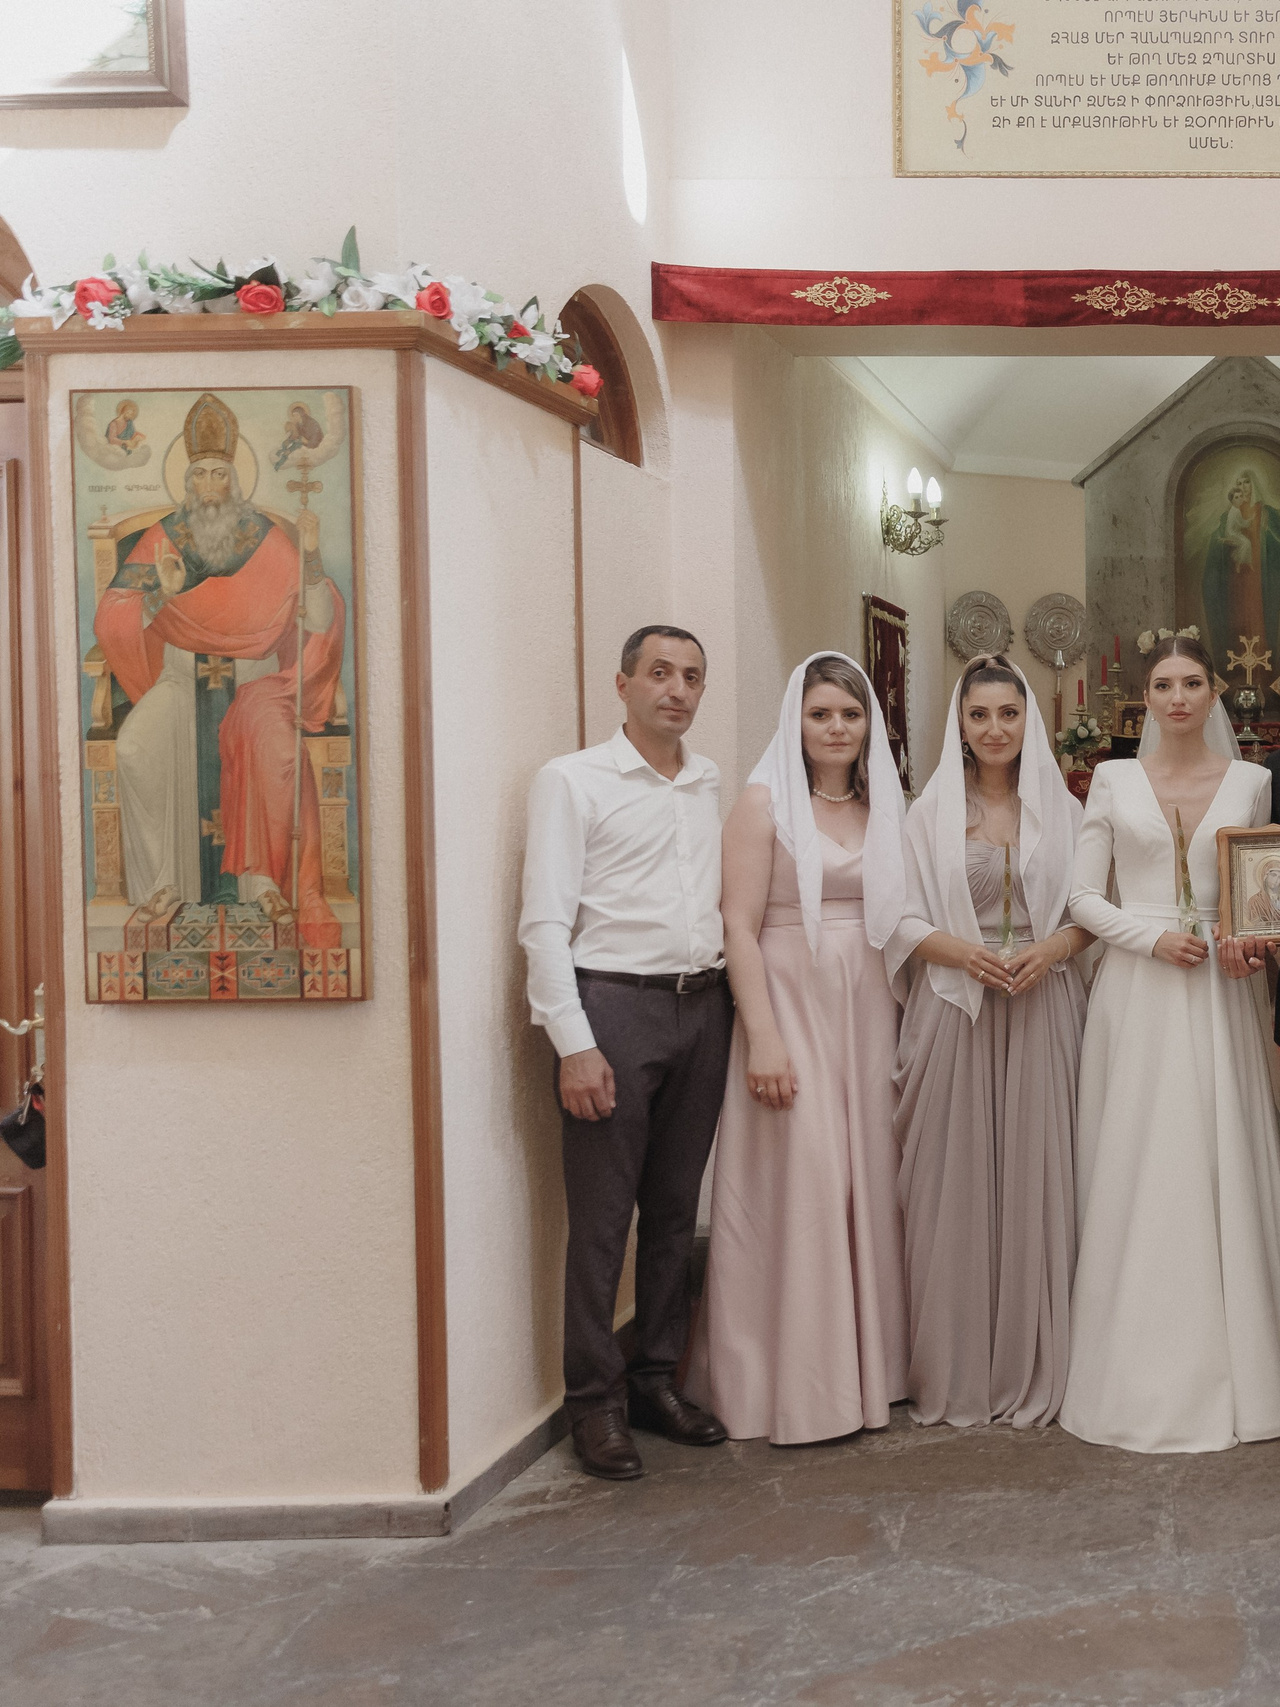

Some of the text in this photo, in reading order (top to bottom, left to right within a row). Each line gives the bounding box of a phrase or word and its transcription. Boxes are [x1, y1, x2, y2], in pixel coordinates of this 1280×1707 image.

[1104, 9, 1154, 23] ՈՐՊԷՍ
[1159, 9, 1228, 23] ՅԵՐԿԻՆՍ
[1233, 9, 1250, 23] ԵՒ
[1050, 31, 1090, 45] ԶՀԱՑ
[1095, 31, 1125, 45] ՄԵՐ
[1130, 31, 1235, 45] ՀԱՆԱՊԱԶՈՐԴ
[1238, 30, 1275, 44] ՏՈՒՐ
[1107, 52, 1124, 66] ԵՒ
[1128, 52, 1162, 66] ԹՈՂ
[1166, 52, 1198, 66] ՄԵԶ
[1202, 51, 1276, 66] ԶՊԱՐՏԻՍ
[1035, 73, 1085, 87] ՈՐՊԷՍ
[1090, 73, 1107, 87] ԵՒ
[1110, 73, 1141, 87] ՄԵՔ
[1145, 73, 1217, 87] ԹՈՂՈՒՄՔ
[1221, 72, 1272, 87] ՄԵՐՈՑ
[990, 95, 1007, 108] ԵՒ
[1010, 95, 1029, 108] ՄԻ
[1034, 94, 1082, 108] ՏԱՆԻՐ
[1086, 94, 1127, 108] ԶՄԵԶ
[1131, 95, 1140, 108] Ի
[991, 115, 1011, 129] ԶԻ
[1015, 115, 1035, 129] ՔՈ
[1040, 115, 1048, 129] Է
[1052, 115, 1158, 129] ԱՐՔԱՅՈՒԹԻՒՆ
[1163, 115, 1180, 129] ԵՒ
[1184, 115, 1274, 129] ԶՕՐՈՒԹԻՒՆ
